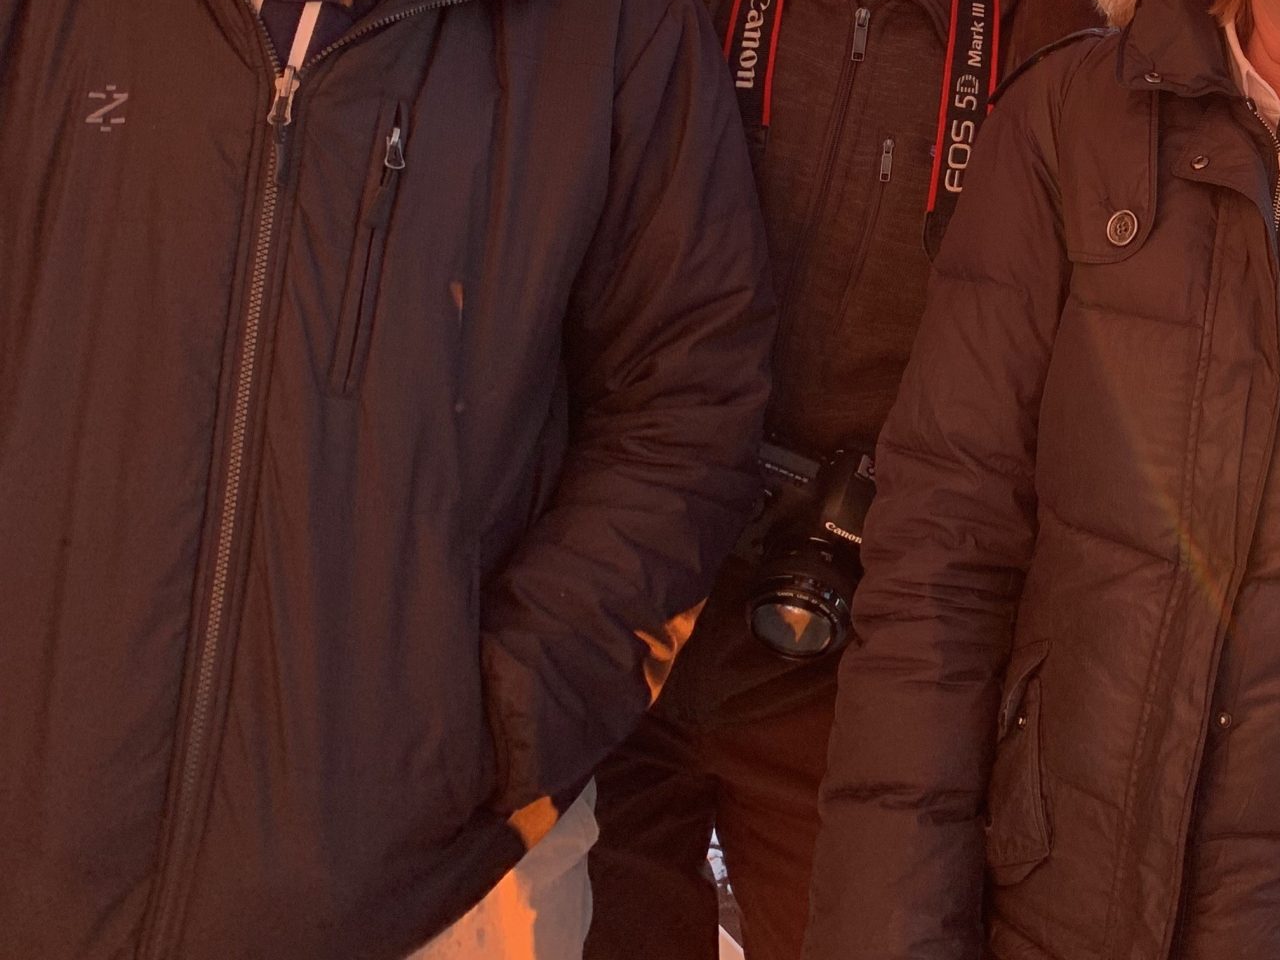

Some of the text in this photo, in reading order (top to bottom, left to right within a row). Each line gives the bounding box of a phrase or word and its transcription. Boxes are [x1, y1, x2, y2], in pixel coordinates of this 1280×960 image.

[972, 2, 985, 17] III
[968, 22, 985, 67] Mark
[955, 74, 979, 111] 5D
[825, 521, 862, 544] Canon
